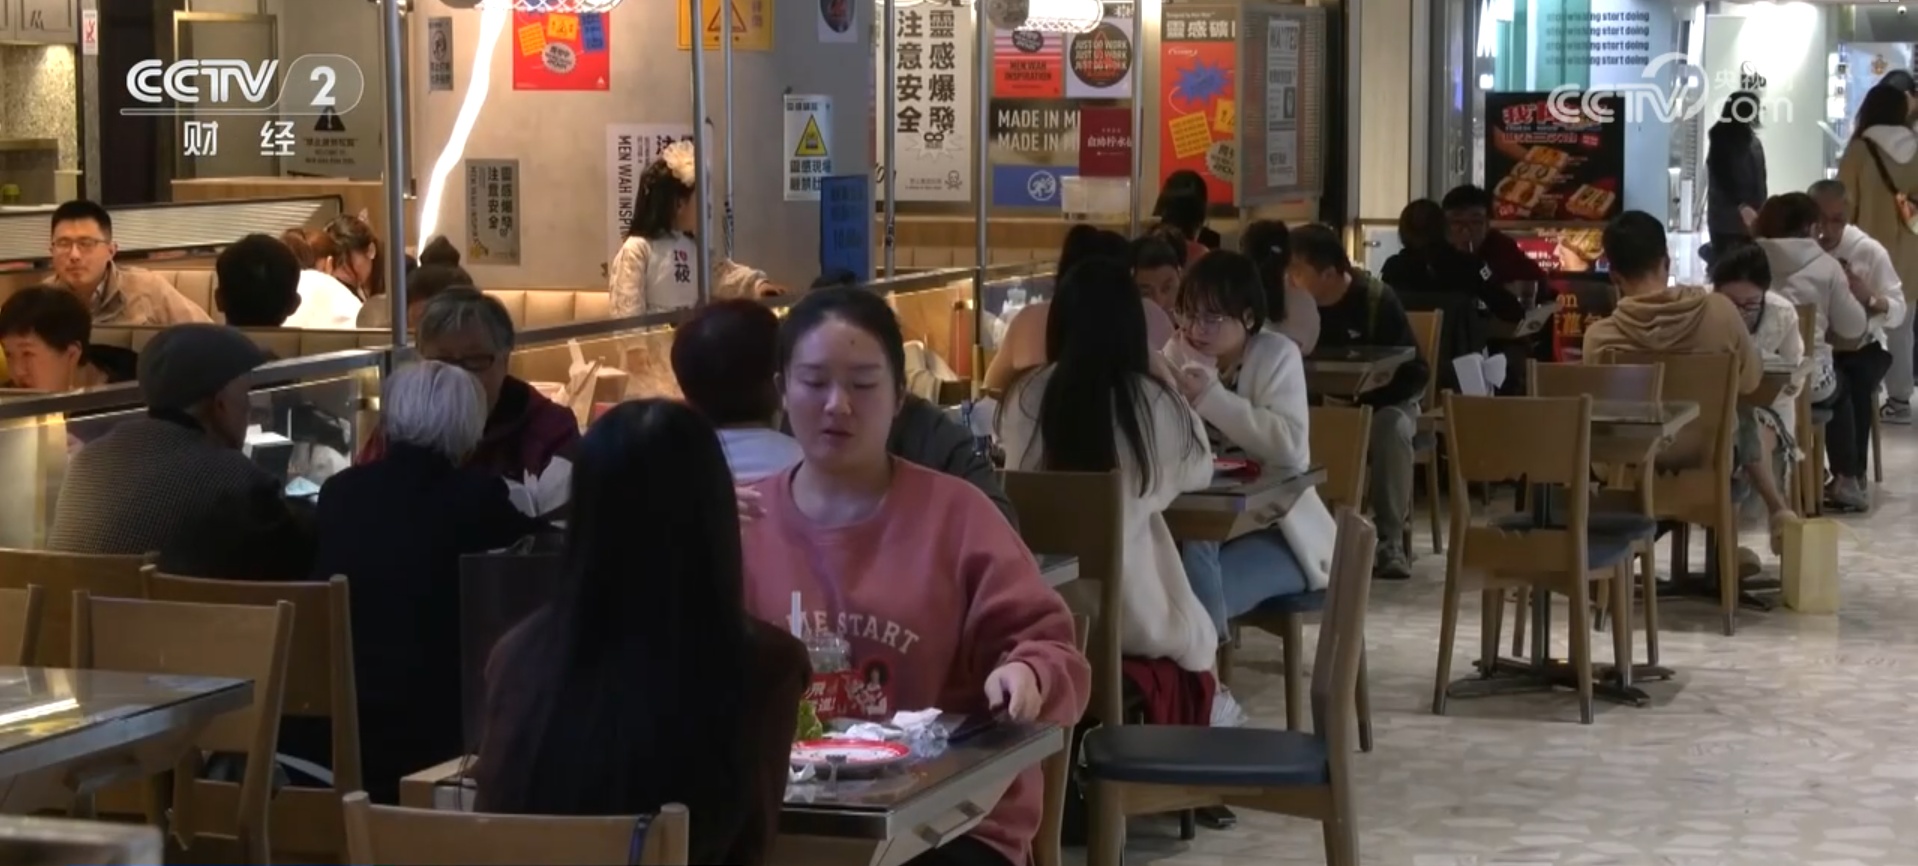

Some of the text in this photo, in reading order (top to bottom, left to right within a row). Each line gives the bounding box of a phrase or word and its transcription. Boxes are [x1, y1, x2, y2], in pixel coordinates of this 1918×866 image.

[1602, 12, 1624, 21] start
[1625, 11, 1649, 22] doing
[1602, 26, 1624, 35] start
[1625, 25, 1649, 36] doing
[1602, 41, 1624, 50] start
[1625, 40, 1649, 51] doing
[1602, 55, 1624, 64] start
[1625, 54, 1649, 65] doing
[896, 10, 923, 133] 注意安全
[998, 109, 1040, 129] MADE
[1043, 109, 1060, 129] IN
[618, 135, 632, 161] MEN
[998, 132, 1040, 151] MADE
[1043, 132, 1060, 151] IN
[618, 164, 632, 194] WAH
[837, 611, 920, 655] START
